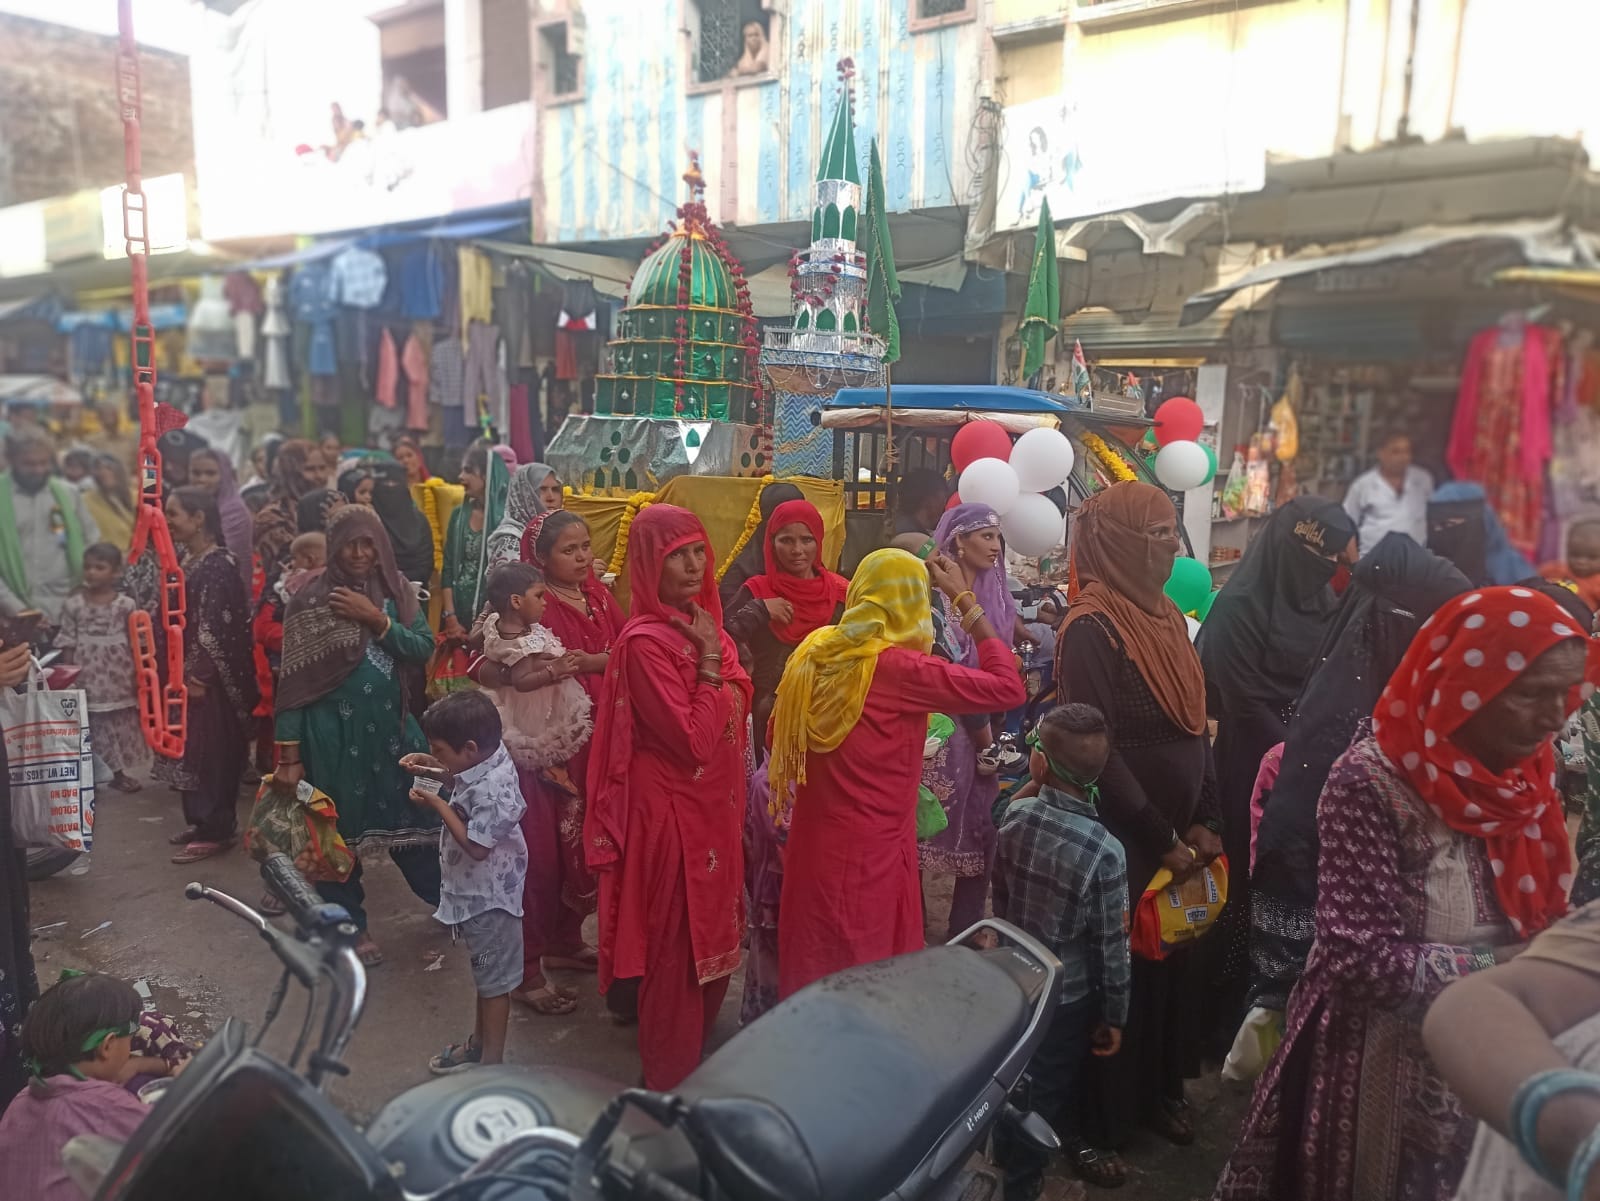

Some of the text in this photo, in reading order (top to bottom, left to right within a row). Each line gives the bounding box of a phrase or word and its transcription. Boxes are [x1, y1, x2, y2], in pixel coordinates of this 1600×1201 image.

[60, 767, 76, 777] NET
[62, 788, 78, 798] BAG
[973, 1101, 989, 1122] Hero
